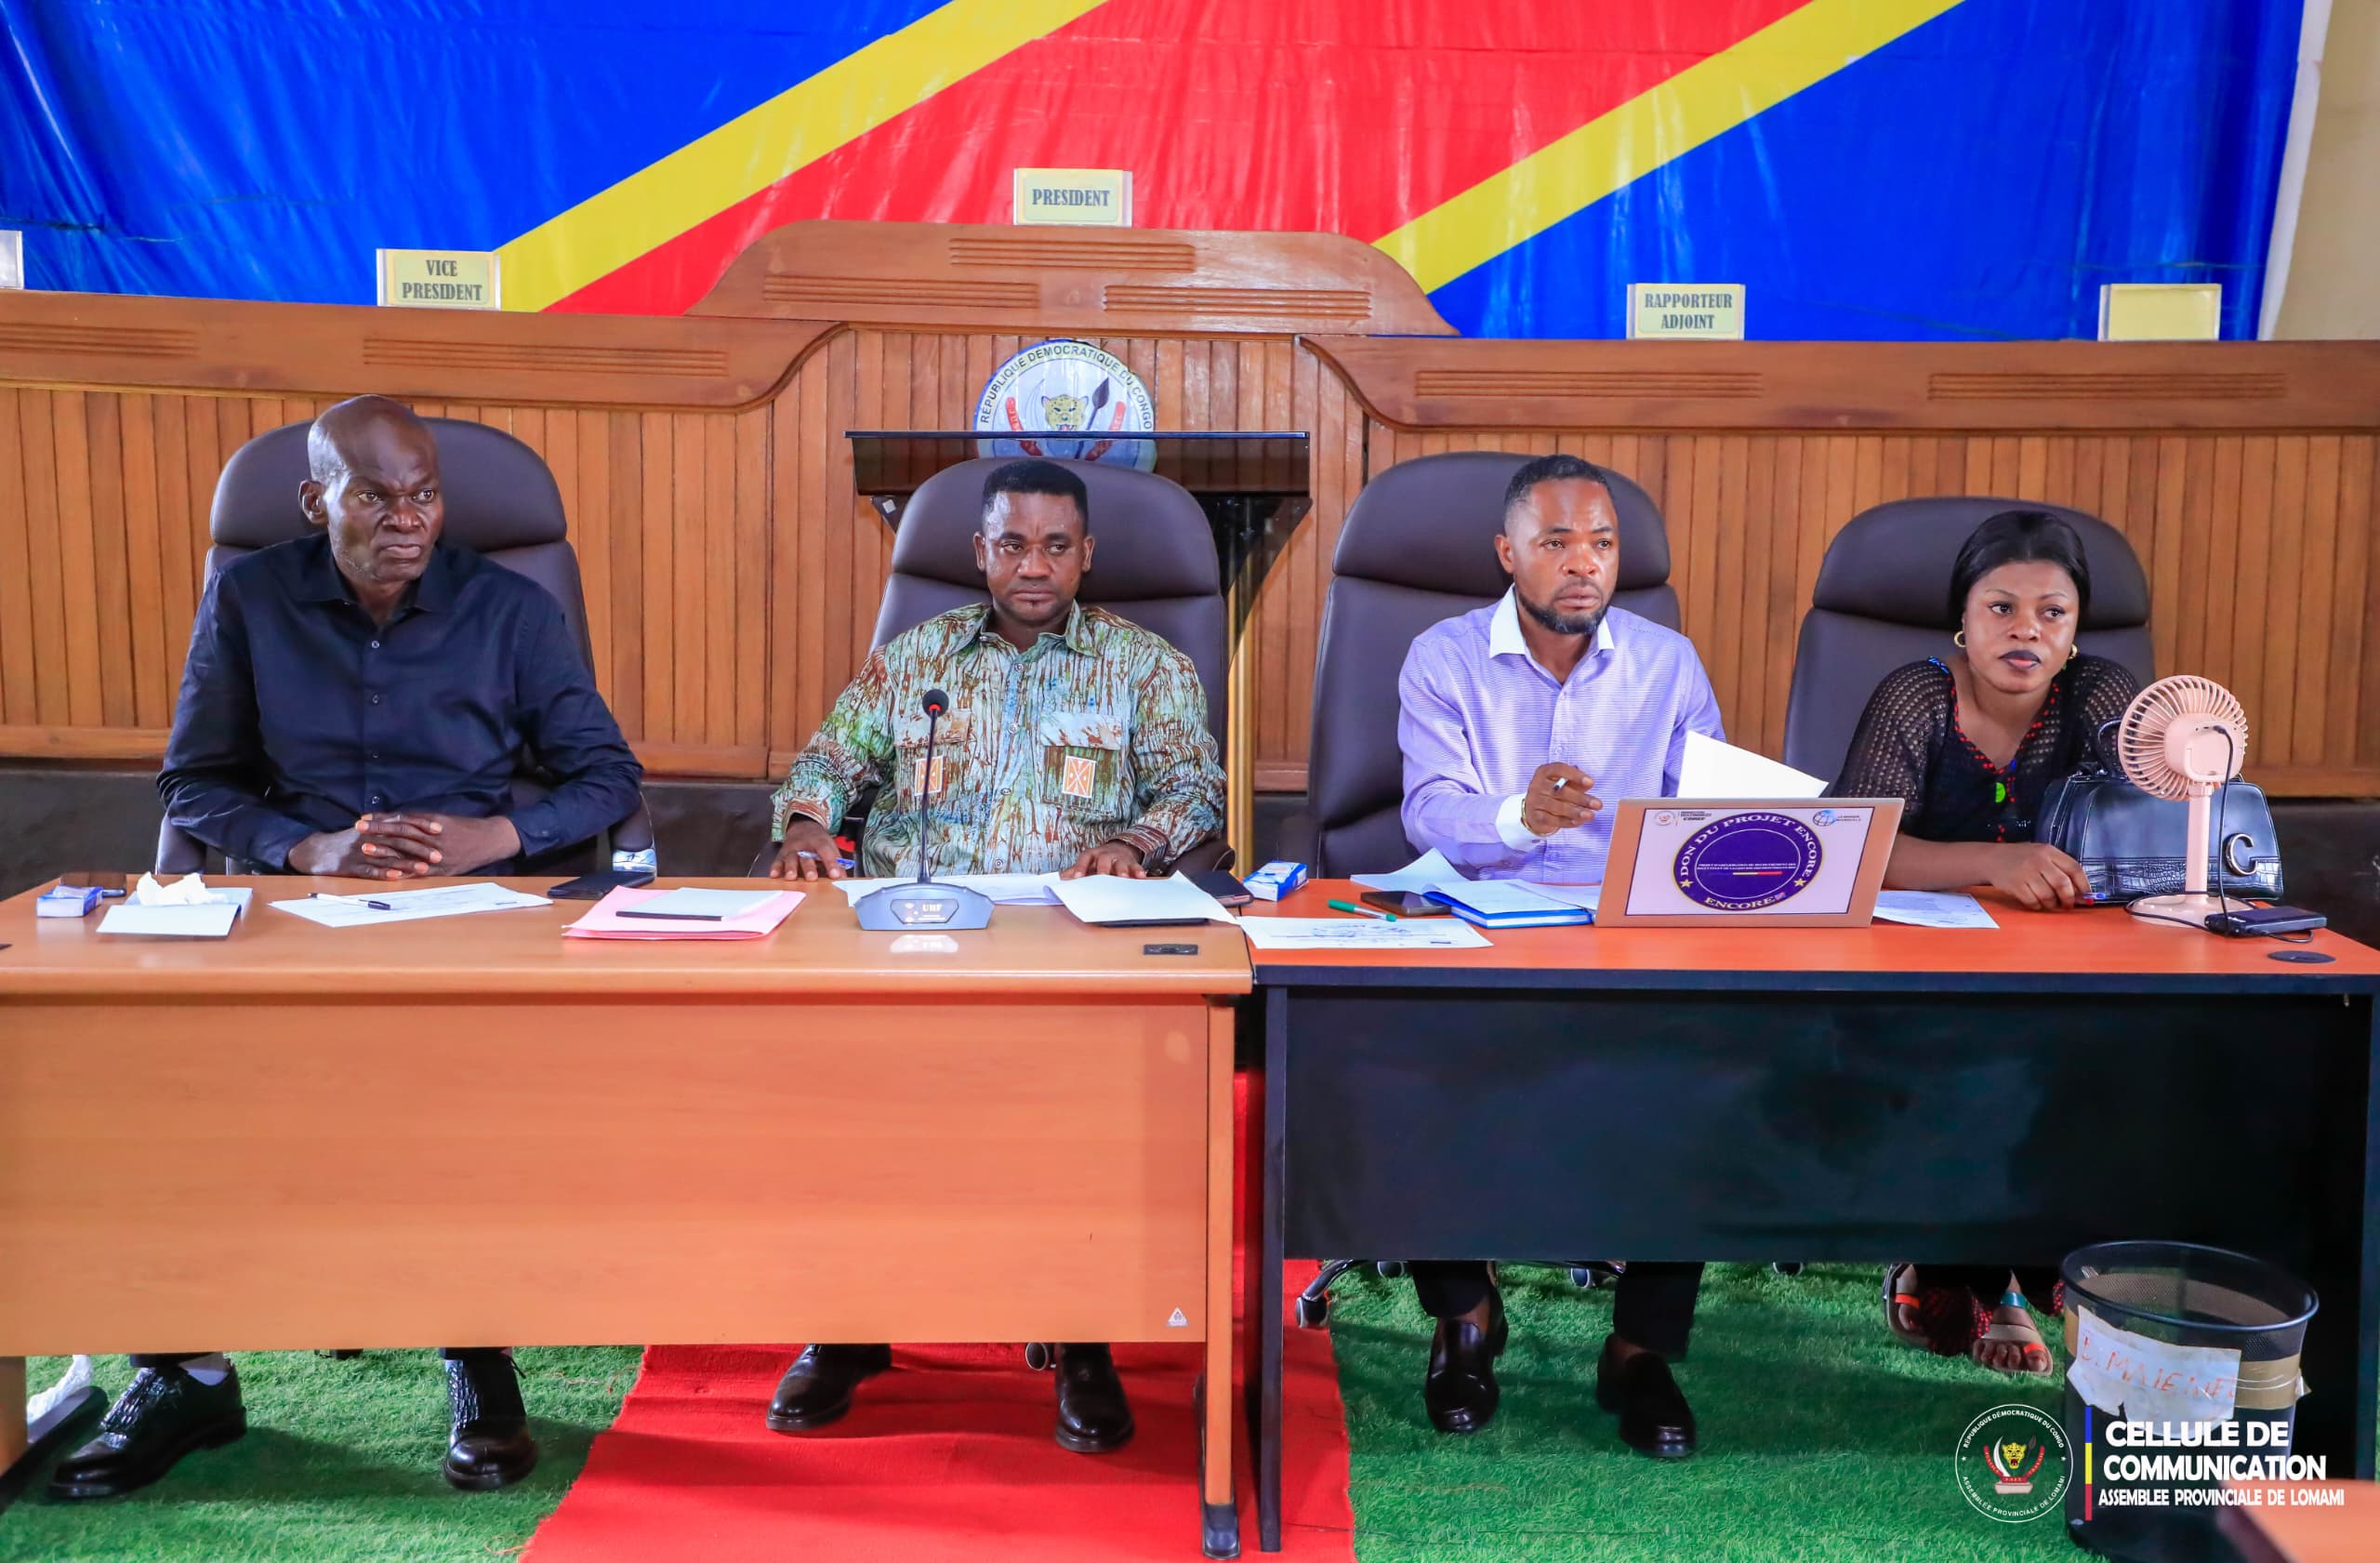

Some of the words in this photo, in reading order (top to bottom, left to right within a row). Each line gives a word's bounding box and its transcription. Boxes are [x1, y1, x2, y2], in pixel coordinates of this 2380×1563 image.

[1032, 188, 1110, 206] PRESIDENT
[426, 259, 457, 277] VICE
[402, 282, 483, 301] PRESIDENT
[1645, 293, 1733, 309] RAPPORTEUR
[1661, 314, 1715, 329] ADJOINT
[981, 357, 1027, 424] REPUBLIQUE
[1027, 345, 1120, 372] DEMOCRATIQUE
[1132, 387, 1153, 430] CONGO
[1680, 846, 1697, 876] DON
[1695, 826, 1719, 844] DU
[1723, 815, 1796, 828] PROJET
[1795, 826, 1818, 878] ENCORE
[1704, 896, 1776, 909] ENCORE
